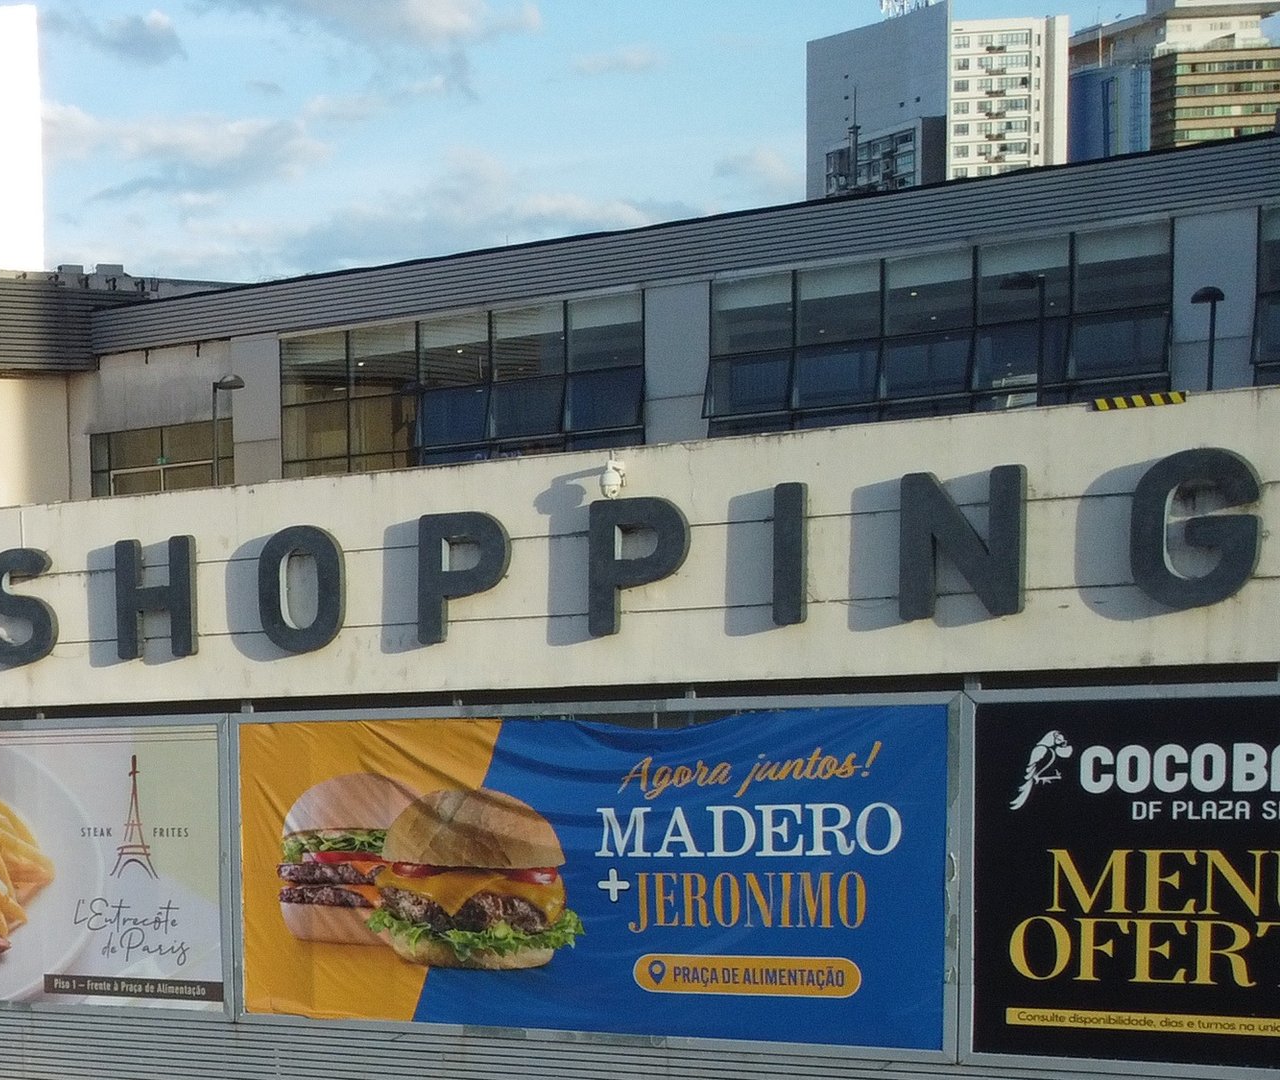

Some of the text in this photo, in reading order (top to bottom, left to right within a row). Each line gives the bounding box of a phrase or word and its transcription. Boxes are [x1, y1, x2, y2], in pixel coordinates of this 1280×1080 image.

[618, 741, 882, 799] Agora juntos!
[1132, 800, 1280, 820] DF PLAZA S
[81, 827, 189, 838] STEAK FRITES
[595, 803, 902, 857] MADERO
[1045, 849, 1280, 917] MEN
[628, 872, 867, 933] JERONIMO
[102, 927, 190, 966] de Paris
[54, 979, 71, 989] Piso
[87, 981, 111, 991] Frente
[114, 981, 119, 991] à
[121, 981, 142, 994] Praça
[145, 983, 155, 993] de
[157, 983, 206, 996] Alimentação
[673, 966, 845, 989] PRAÇA DE ALIMENTAÇÃO
[1017, 1011, 1066, 1023] Consulte
[1160, 1017, 1184, 1028] dias
[1239, 1022, 1255, 1031] na
